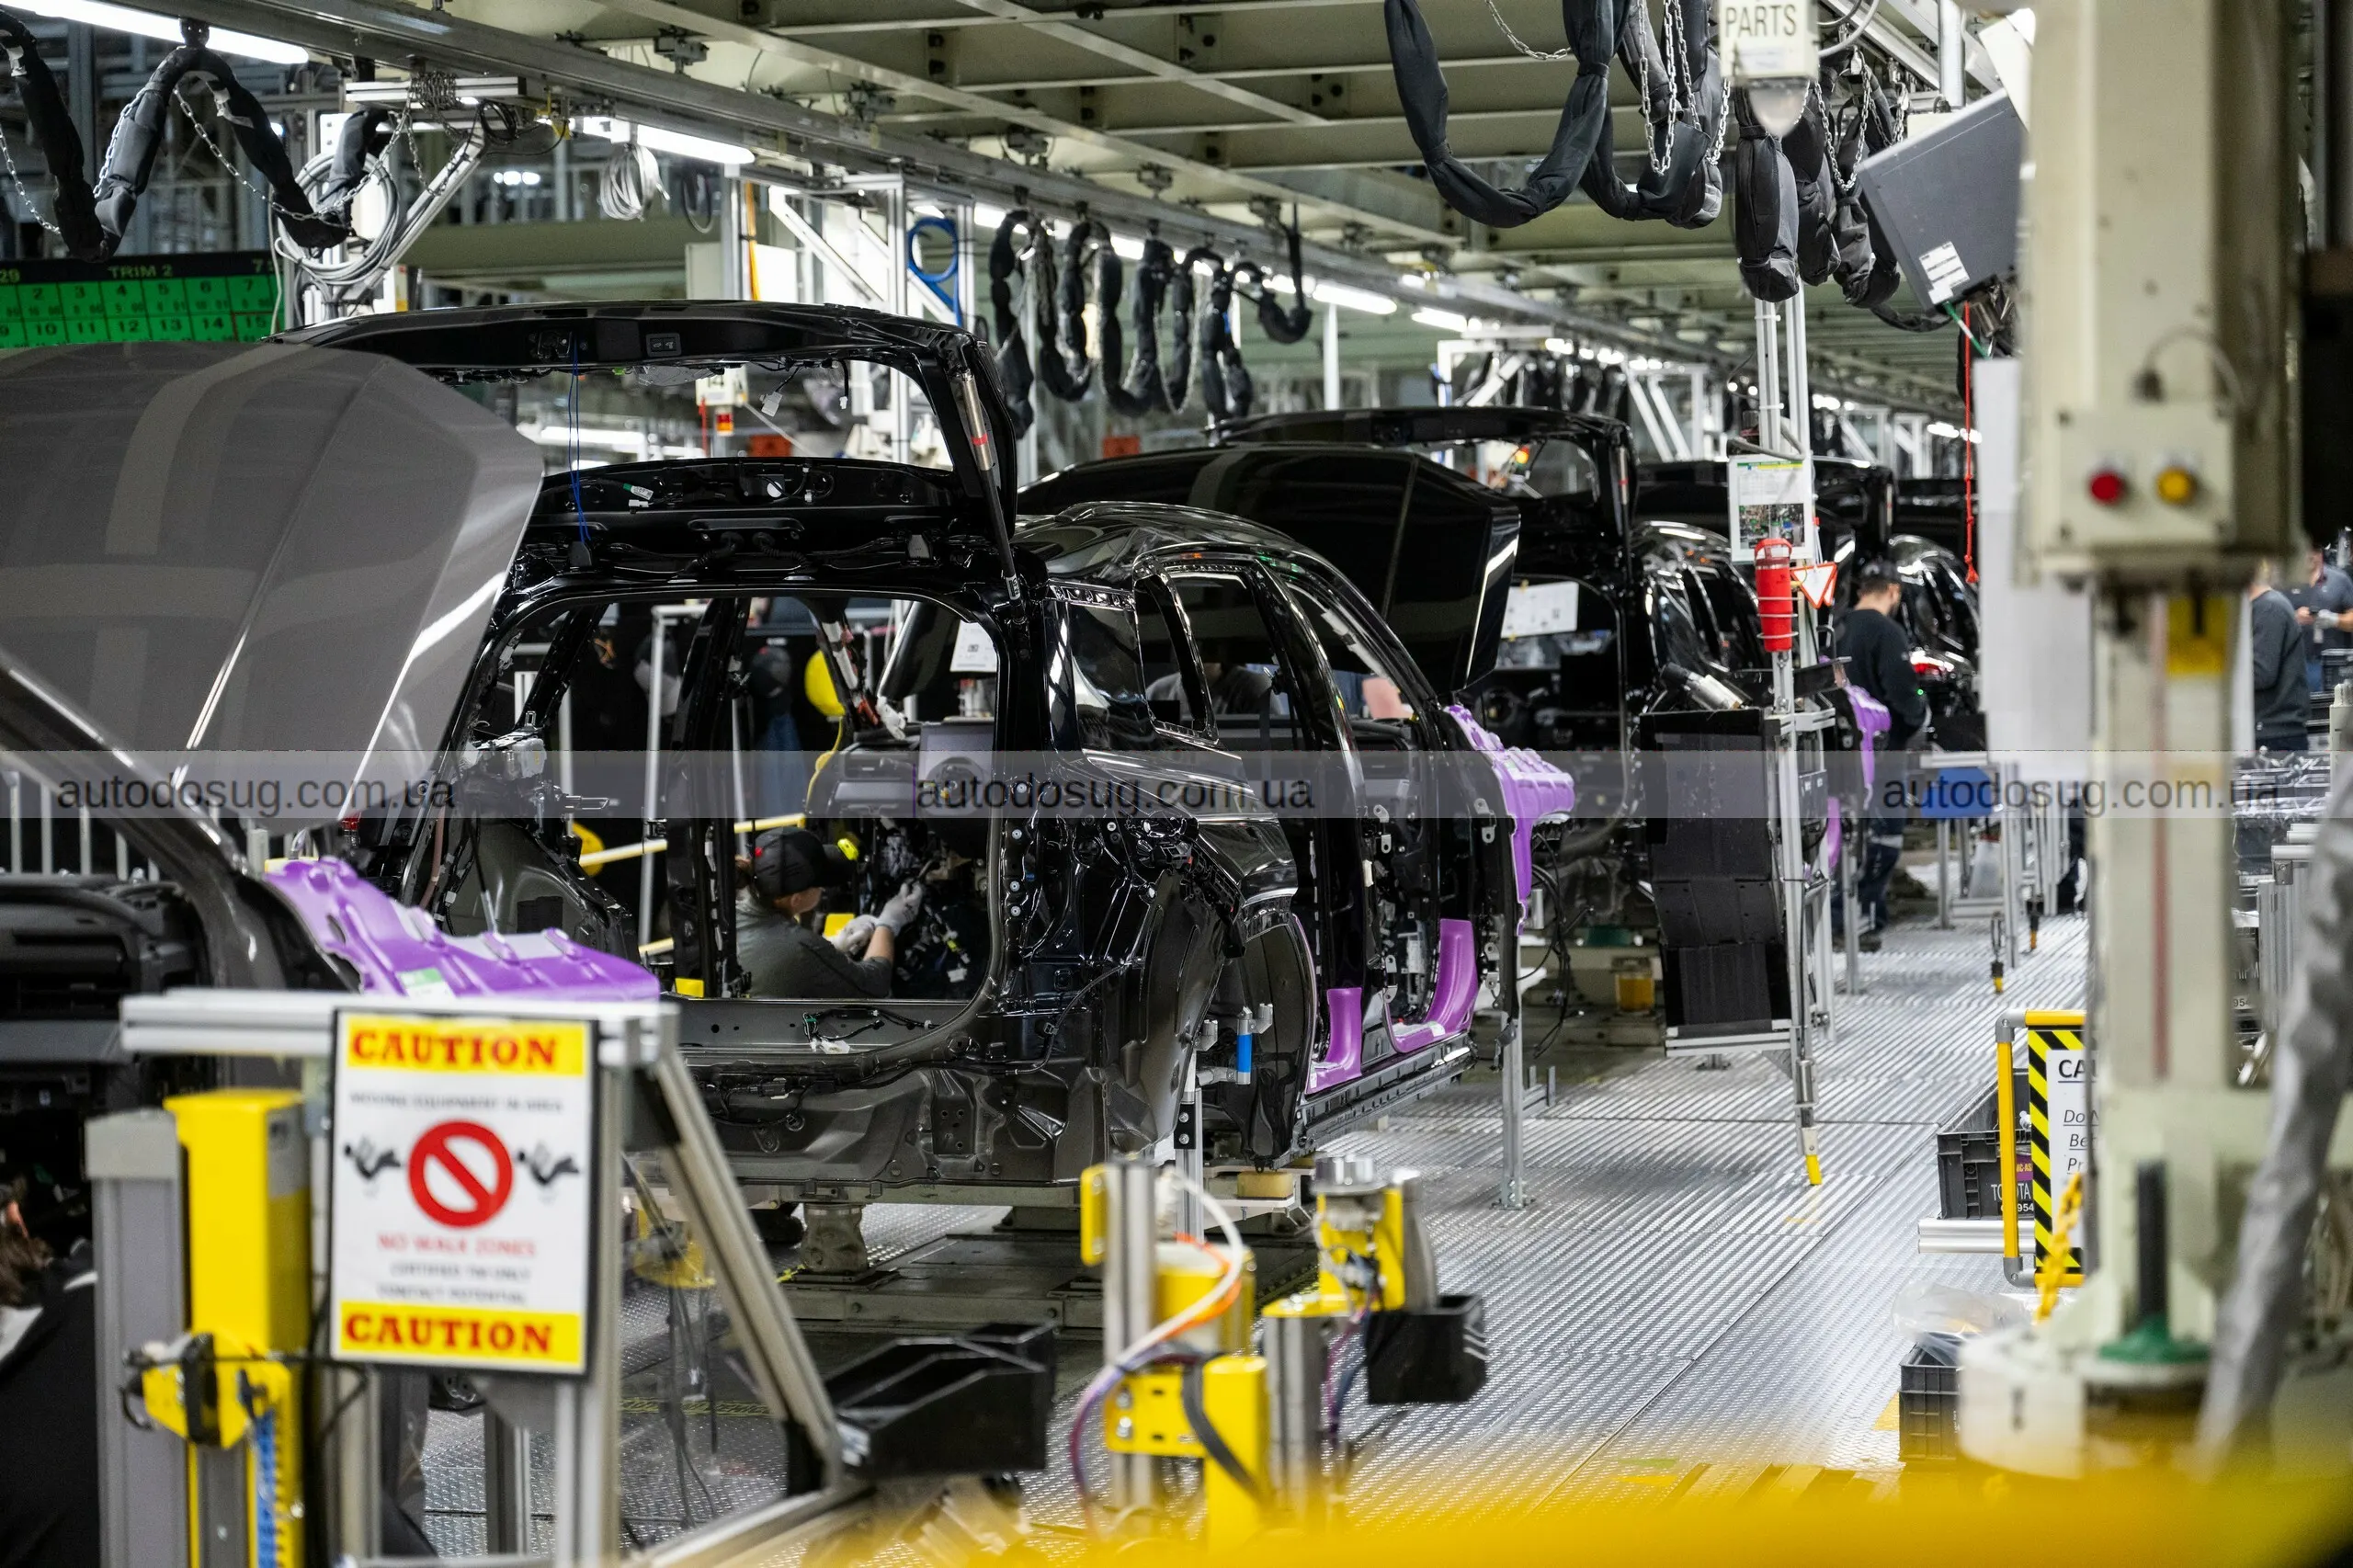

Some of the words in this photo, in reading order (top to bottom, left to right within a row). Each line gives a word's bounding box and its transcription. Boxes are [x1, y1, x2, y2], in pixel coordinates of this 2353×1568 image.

[1725, 4, 1797, 38] PARTS
[108, 265, 156, 278] TRIM
[161, 265, 174, 278] 2
[116, 284, 128, 297] 4
[244, 278, 255, 291] 7
[36, 323, 57, 336] 10
[77, 322, 96, 335] 11
[119, 320, 139, 333] 12
[203, 317, 223, 330] 14
[353, 1029, 557, 1067] CAUTION
[1991, 1183, 2031, 1201] TOTA
[346, 1312, 551, 1353] CAUTION
